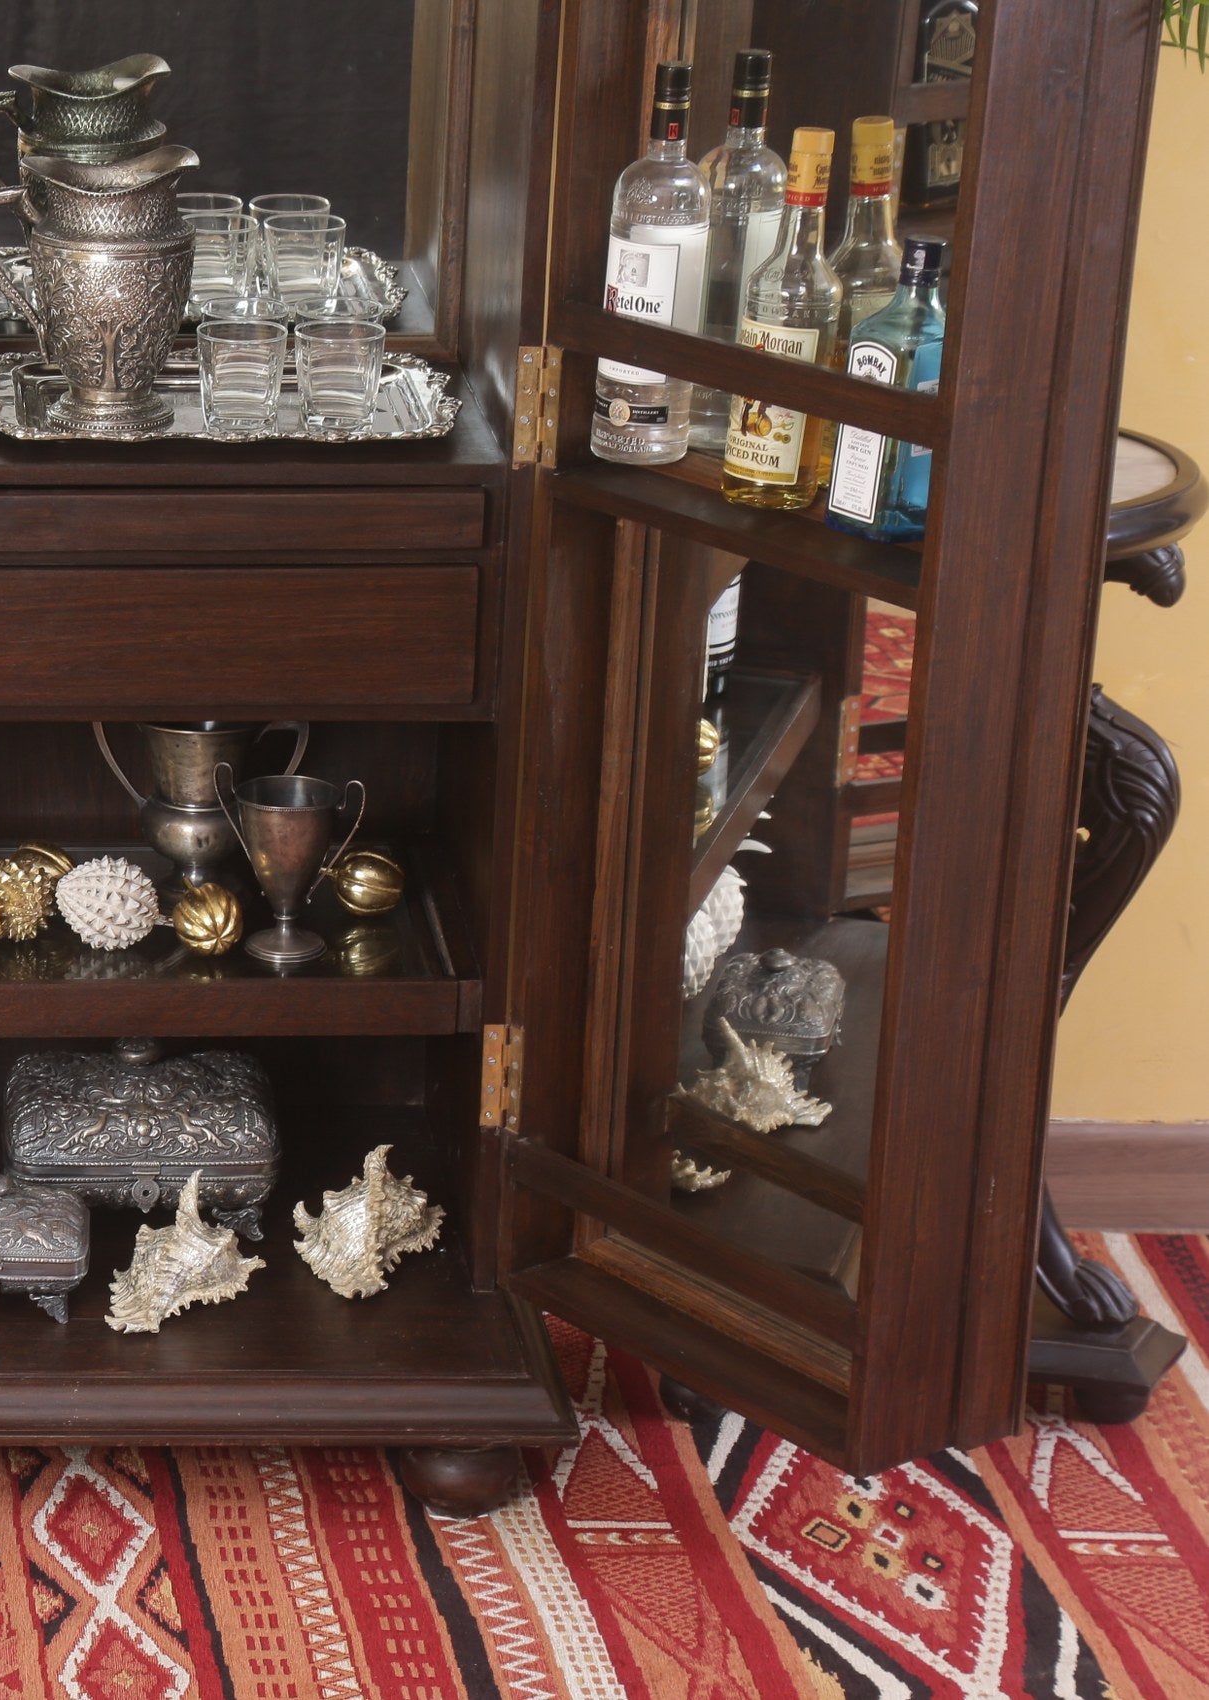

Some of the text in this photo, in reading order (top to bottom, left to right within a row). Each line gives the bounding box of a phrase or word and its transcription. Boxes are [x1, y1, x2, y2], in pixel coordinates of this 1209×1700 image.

[635, 296, 662, 314] One
[856, 355, 888, 374] BOMBAY
[751, 452, 780, 468] RUM
